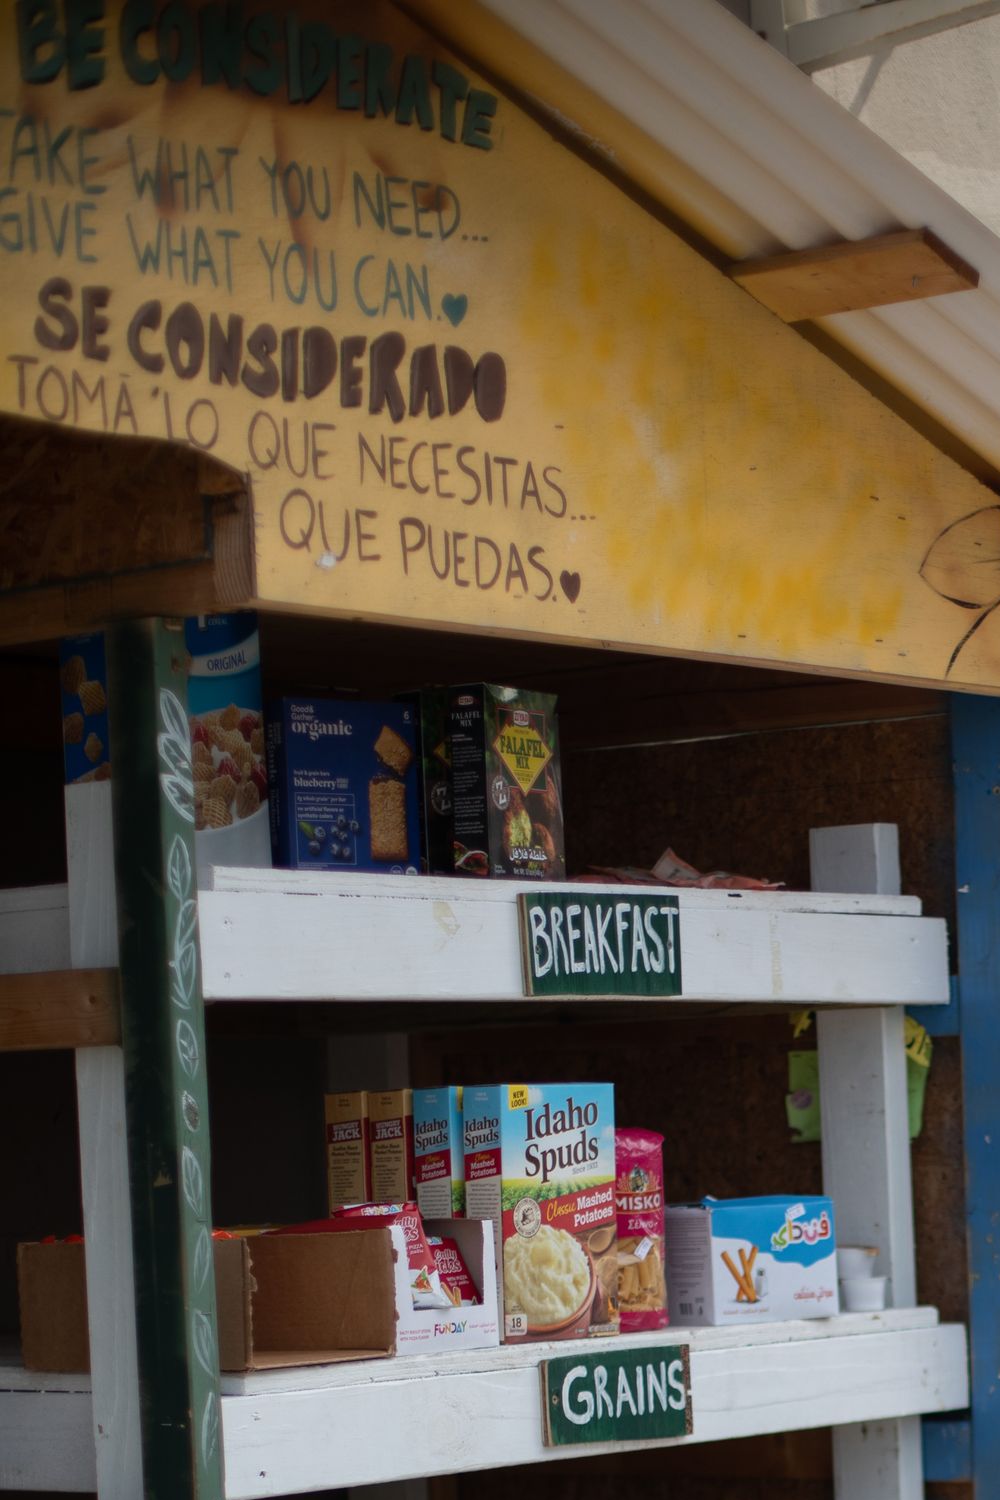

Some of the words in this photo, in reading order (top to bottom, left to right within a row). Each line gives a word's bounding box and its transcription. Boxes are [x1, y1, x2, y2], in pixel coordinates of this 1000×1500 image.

[17, 1, 106, 91] BE
[119, 1, 498, 150] CONSIDERATE
[127, 133, 240, 215] WHAT
[257, 155, 333, 223] YOU
[0, 185, 99, 264] GIVE
[126, 212, 242, 294] WHAT
[257, 237, 338, 311] YOU
[34, 276, 113, 361] SE
[126, 299, 508, 424] CONSIDERADO
[248, 410, 336, 479] QUE
[279, 488, 381, 562] QUE
[207, 649, 248, 672] ORIGINAL
[451, 710, 480, 720] FALAFEL
[460, 720, 473, 728] MIX
[291, 719, 353, 741] organic
[500, 735, 546, 759] FALAFEL
[515, 755, 530, 770] MIX
[293, 777, 337, 790] blueberry
[529, 902, 679, 979] BREAKFAST
[512, 1090, 525, 1099] NEW
[415, 1117, 448, 1136] Idaho
[464, 1115, 499, 1133] Idaho
[524, 1096, 598, 1142] Idaho
[332, 1128, 360, 1142] JACK
[375, 1126, 403, 1140] JACK
[415, 1131, 448, 1151] Spuds
[464, 1129, 499, 1149] Spuds
[421, 1160, 445, 1172] Mashed
[470, 1159, 495, 1170] Mashed
[524, 1130, 599, 1184] Spuds
[421, 1168, 447, 1181] Potatoes
[470, 1167, 497, 1179] Potatoes
[361, 1203, 404, 1217] FUNDAY
[546, 1200, 577, 1222] Classic
[576, 1187, 613, 1211] Mashed
[615, 1193, 661, 1211] MISKO
[573, 1205, 614, 1228] Potatoes
[434, 1320, 468, 1337] FUNDAY
[511, 1317, 522, 1329] 18
[562, 1358, 688, 1425] GRAINS
